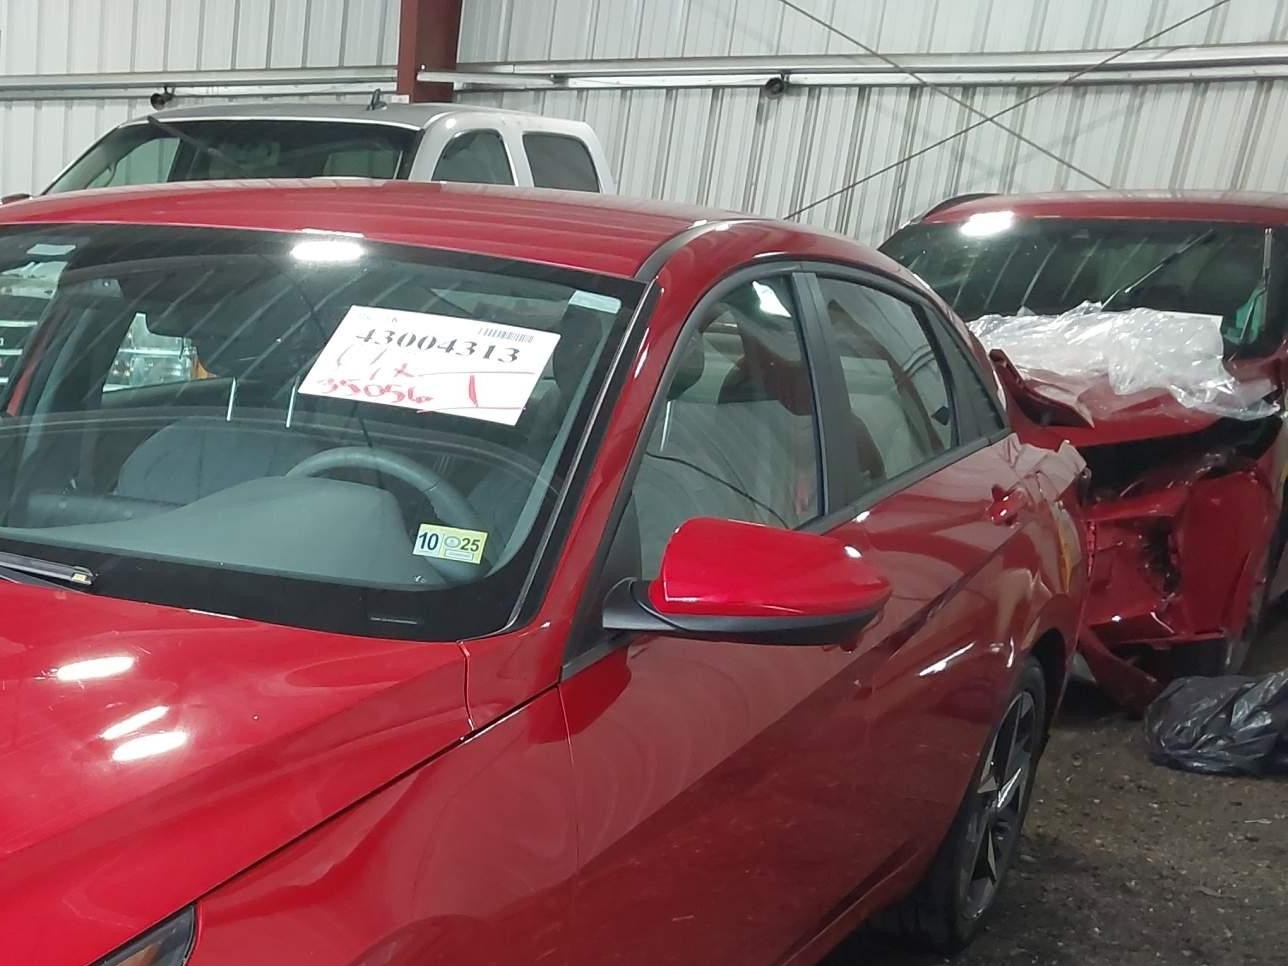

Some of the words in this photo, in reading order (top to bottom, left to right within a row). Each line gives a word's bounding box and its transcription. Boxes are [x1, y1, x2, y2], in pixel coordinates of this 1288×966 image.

[355, 328, 521, 363] 43004313
[418, 531, 440, 551] 10
[459, 537, 481, 552] 25
